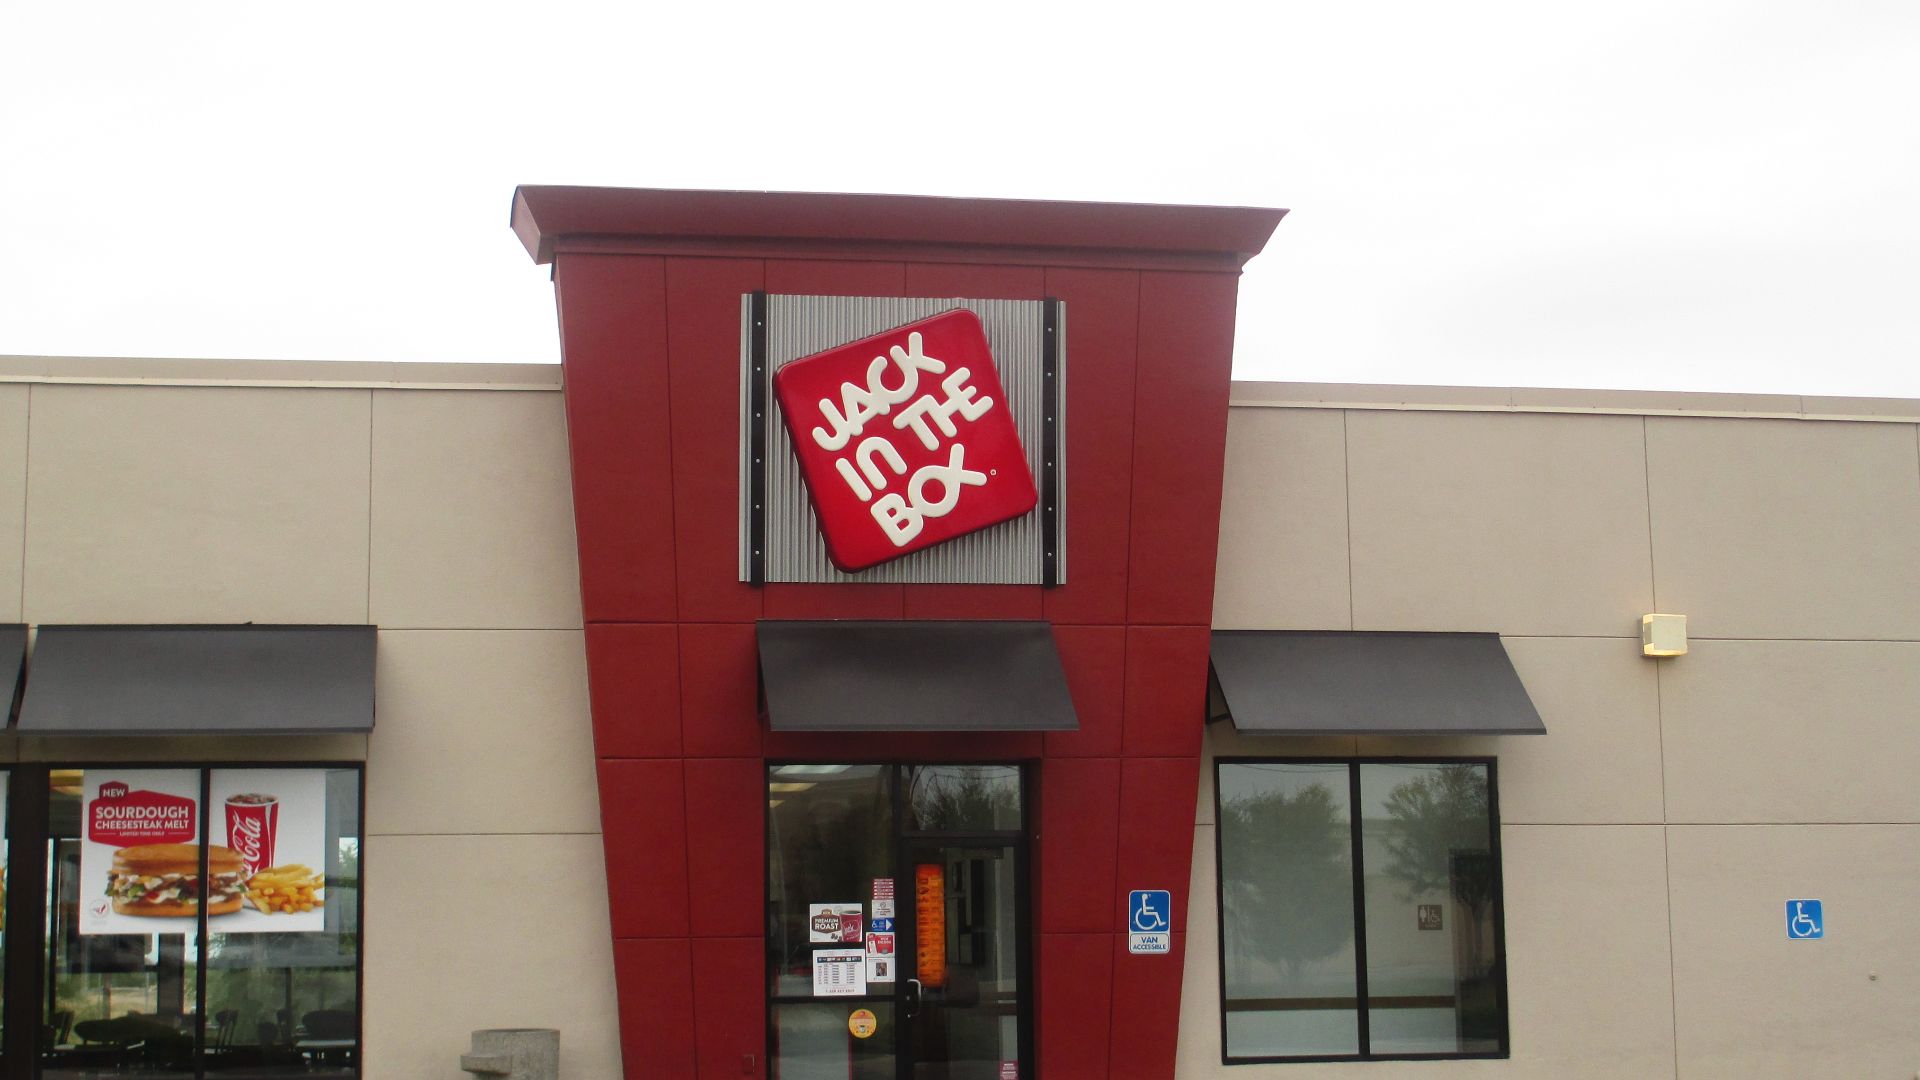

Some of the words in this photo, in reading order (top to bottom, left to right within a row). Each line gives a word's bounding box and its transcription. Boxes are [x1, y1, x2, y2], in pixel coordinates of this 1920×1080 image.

[812, 331, 946, 451] JACK
[835, 436, 907, 502] IN
[893, 367, 993, 451] THE
[870, 443, 987, 547] BOX
[95, 806, 189, 819] SOURDOUGH
[102, 788, 126, 798] NEW
[95, 820, 162, 830] CHEESESTEAK
[164, 820, 189, 829] MELT
[233, 810, 261, 862] Cola
